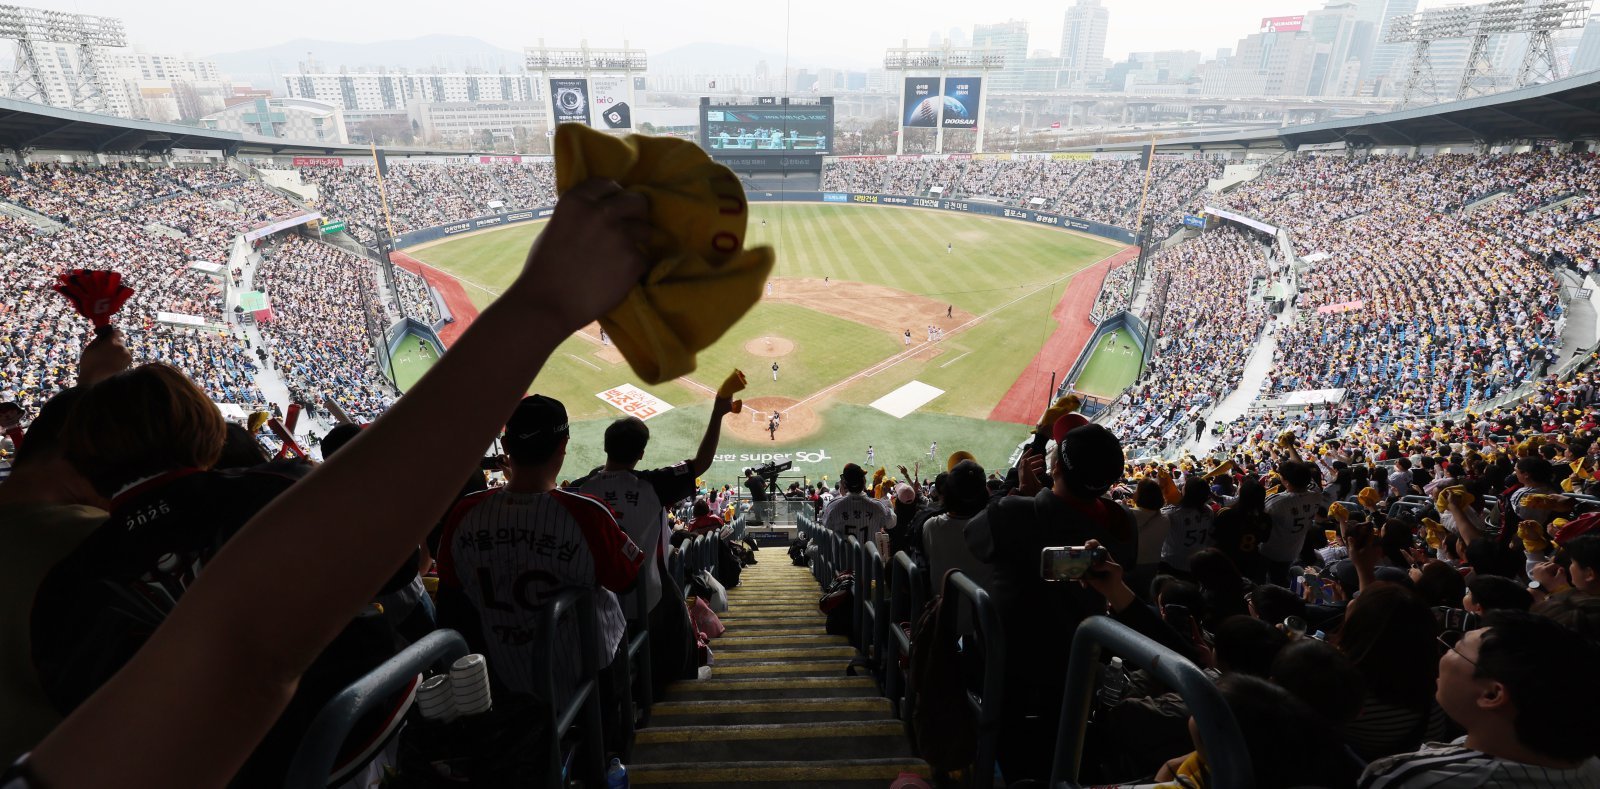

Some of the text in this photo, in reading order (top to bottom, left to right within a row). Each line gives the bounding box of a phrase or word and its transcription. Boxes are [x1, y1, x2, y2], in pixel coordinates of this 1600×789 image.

[854, 195, 878, 203] 대방건설
[944, 201, 968, 211] 금천미트
[604, 388, 657, 419] 백조씽크
[740, 452, 793, 464] super
[460, 527, 579, 561] 서울의자존심
[1183, 528, 1208, 547] 51
[1239, 533, 1257, 553] 8
[476, 567, 561, 613] LG
